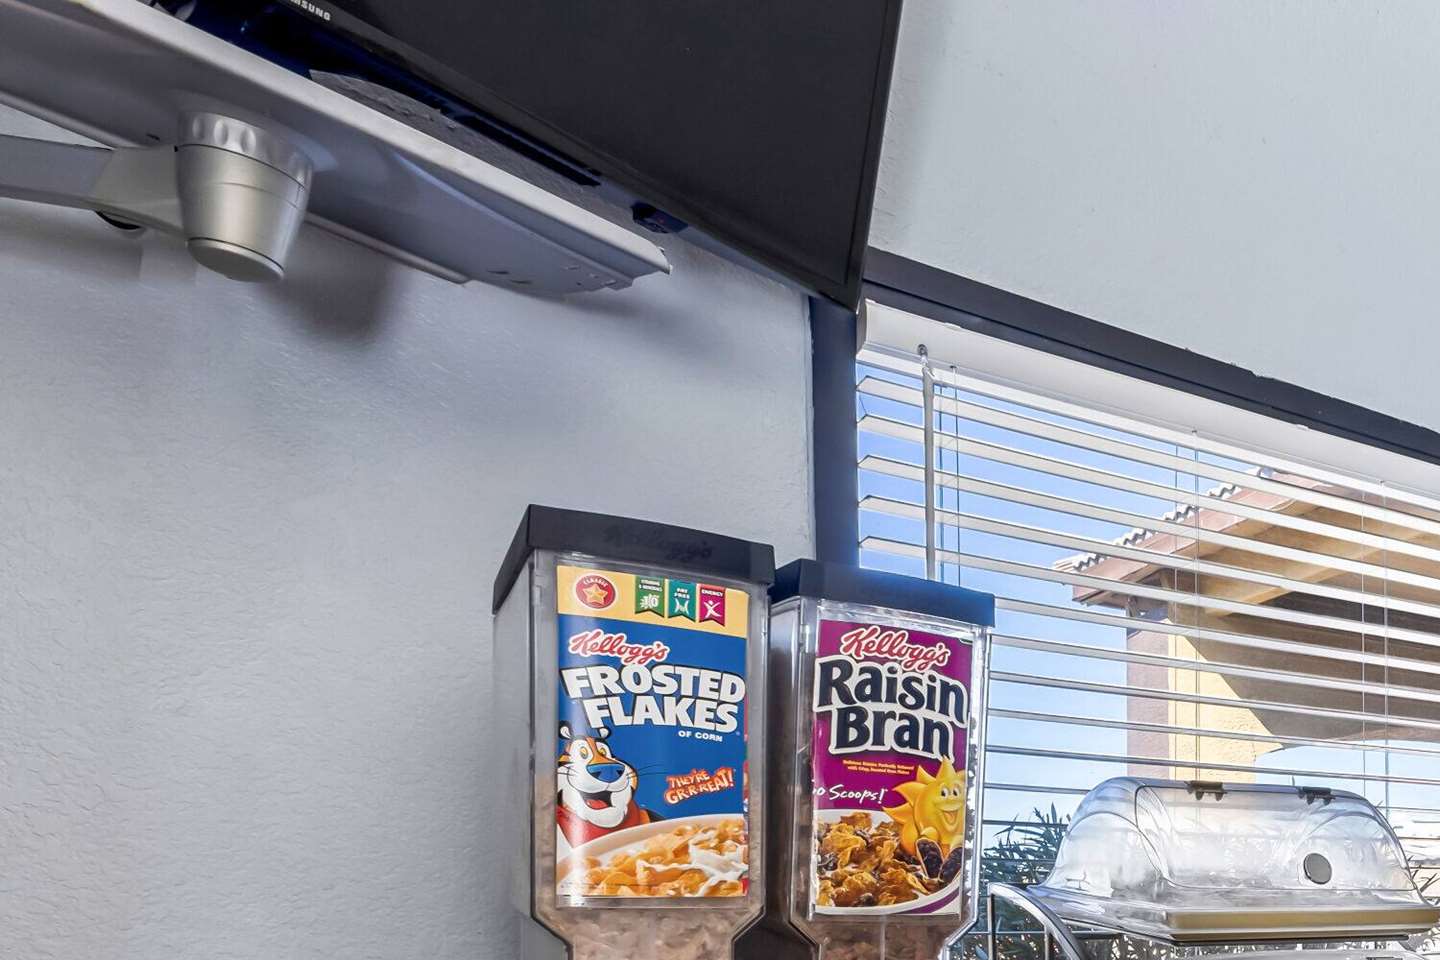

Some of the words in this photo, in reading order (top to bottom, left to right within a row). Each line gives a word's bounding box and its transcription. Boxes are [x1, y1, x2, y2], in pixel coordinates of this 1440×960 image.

[290, 0, 331, 21] SUNG
[570, 630, 668, 664] Kellogg's
[842, 627, 949, 670] Kellogg's
[560, 663, 746, 703] FROSTED
[817, 659, 966, 725] Raisin
[583, 695, 739, 733] FLAKES
[835, 706, 950, 757] Bran
[678, 730, 692, 738] OF
[695, 732, 723, 742] CORN
[829, 784, 884, 804] Scoops!
